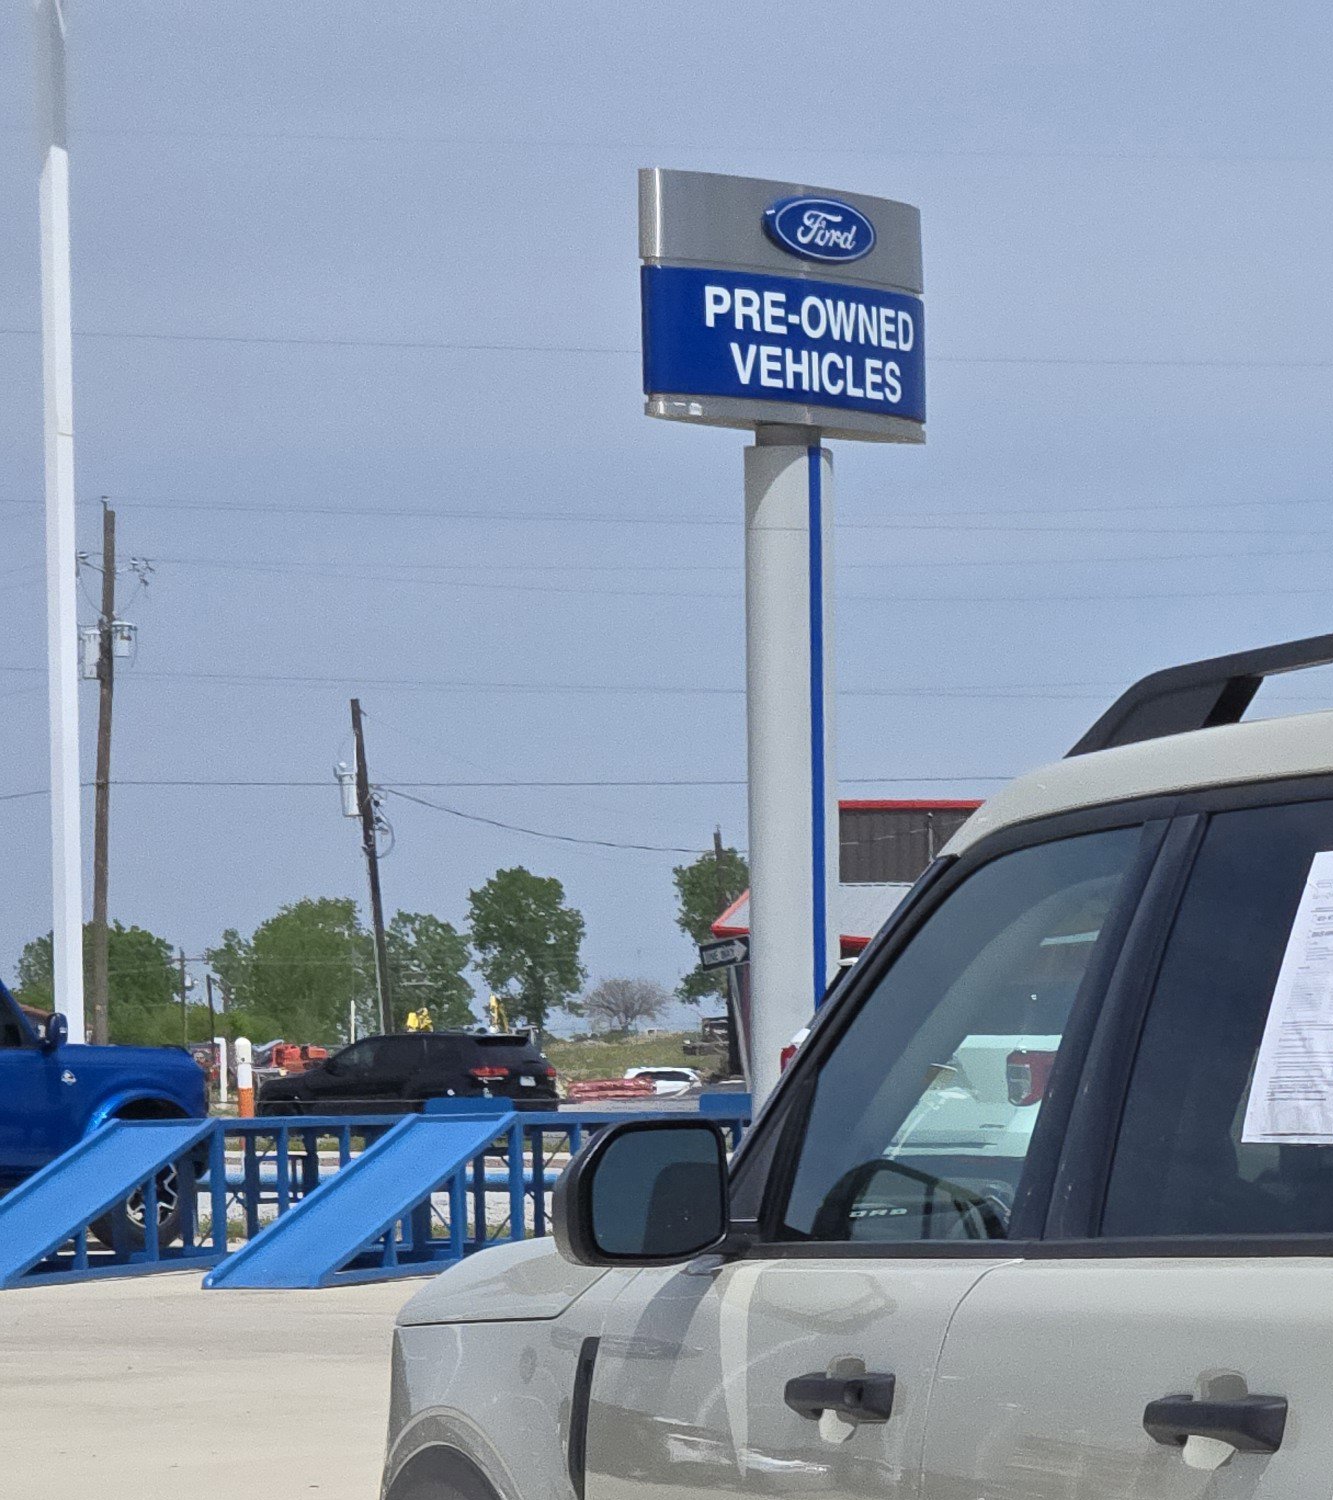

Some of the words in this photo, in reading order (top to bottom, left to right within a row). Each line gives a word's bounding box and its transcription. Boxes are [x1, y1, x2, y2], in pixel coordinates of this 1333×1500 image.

[797, 209, 856, 250] Ford
[704, 285, 914, 351] PRE-OWNED
[730, 342, 902, 404] VEHICLES
